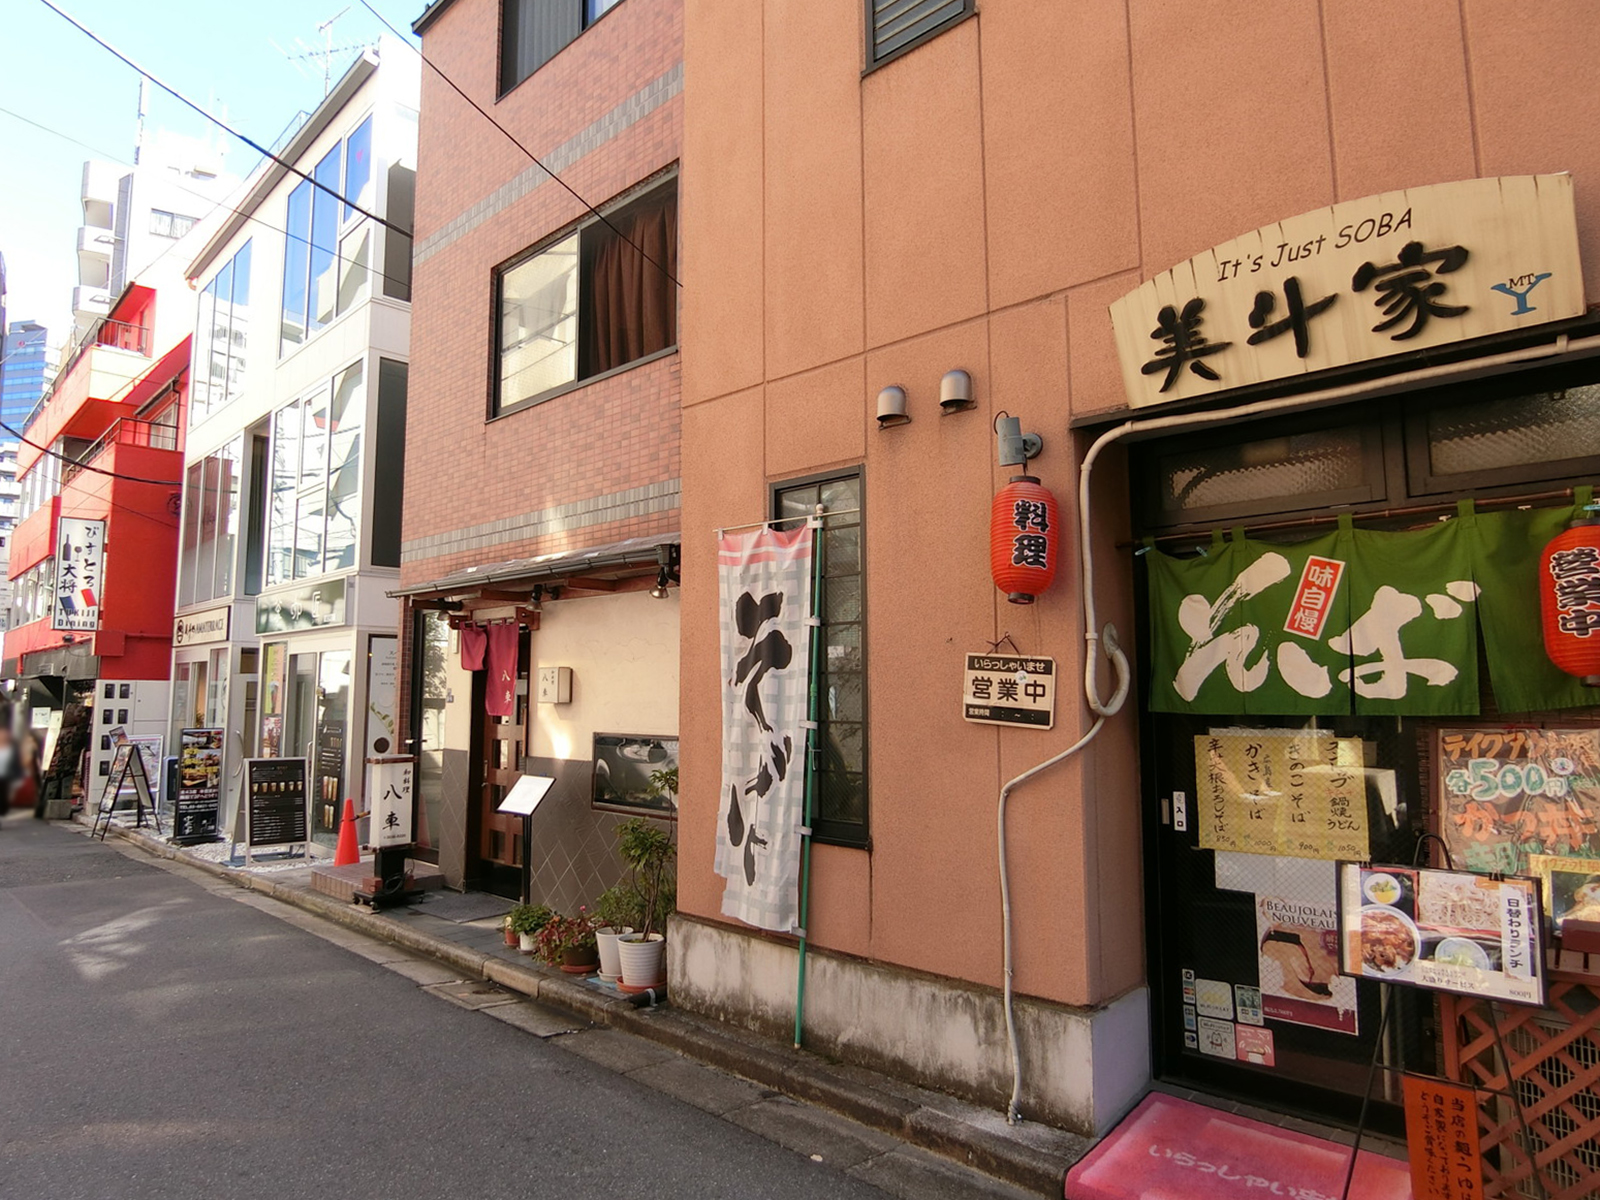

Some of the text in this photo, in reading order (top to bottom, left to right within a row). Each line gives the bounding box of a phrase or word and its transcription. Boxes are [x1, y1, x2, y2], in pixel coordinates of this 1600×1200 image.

[1217, 207, 1413, 283] It's Just SOBA
[1508, 273, 1535, 289] MT
[1141, 240, 1470, 394] 美斗家
[1012, 499, 1050, 570] 料理
[83, 526, 99, 588] びすとろ
[58, 563, 78, 594] 大将
[1292, 564, 1335, 635] 味自慢
[59, 608, 96, 617] TUKIJI
[57, 618, 96, 629] Dining
[1172, 550, 1482, 702] そば
[974, 658, 1046, 673] いらっしゃいませ
[971, 675, 1046, 705] 営業中
[968, 707, 991, 718] 営業時間
[1175, 806, 1184, 827] 入口
[1327, 818, 1361, 832] うどん
[1253, 839, 1277, 852] 1000円
[1298, 841, 1320, 855] 900円
[1337, 843, 1362, 858] 1050円
[1272, 911, 1335, 930] NOUVEAU
[1505, 897, 1525, 969] 日替わりランチ
